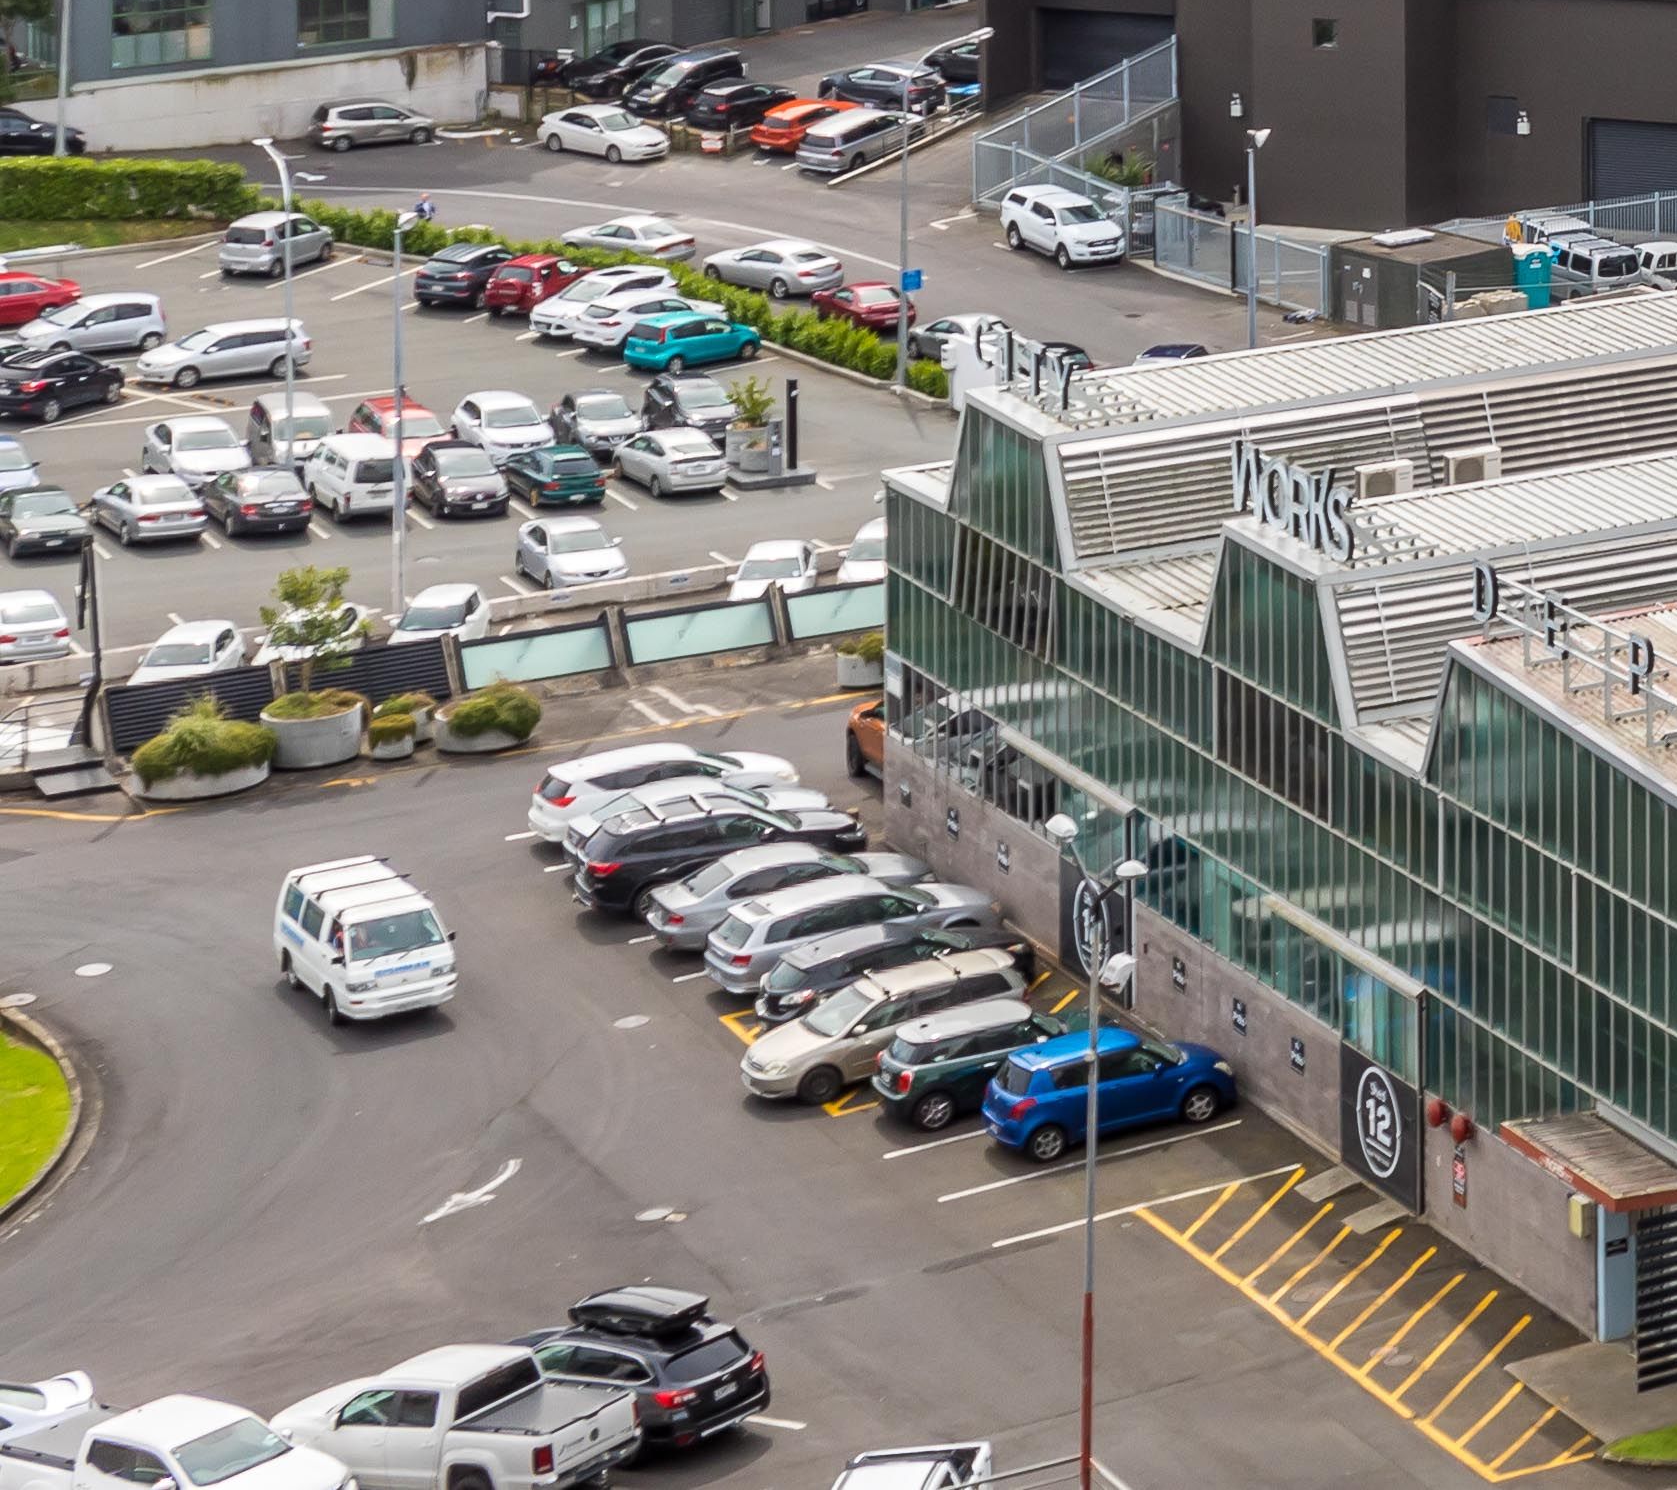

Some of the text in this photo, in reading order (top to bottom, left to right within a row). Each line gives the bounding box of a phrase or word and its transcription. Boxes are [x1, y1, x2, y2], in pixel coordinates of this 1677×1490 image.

[976, 317, 1074, 411] CITY
[1231, 438, 1355, 563] WORKS
[1365, 1098, 1392, 1148] 12
